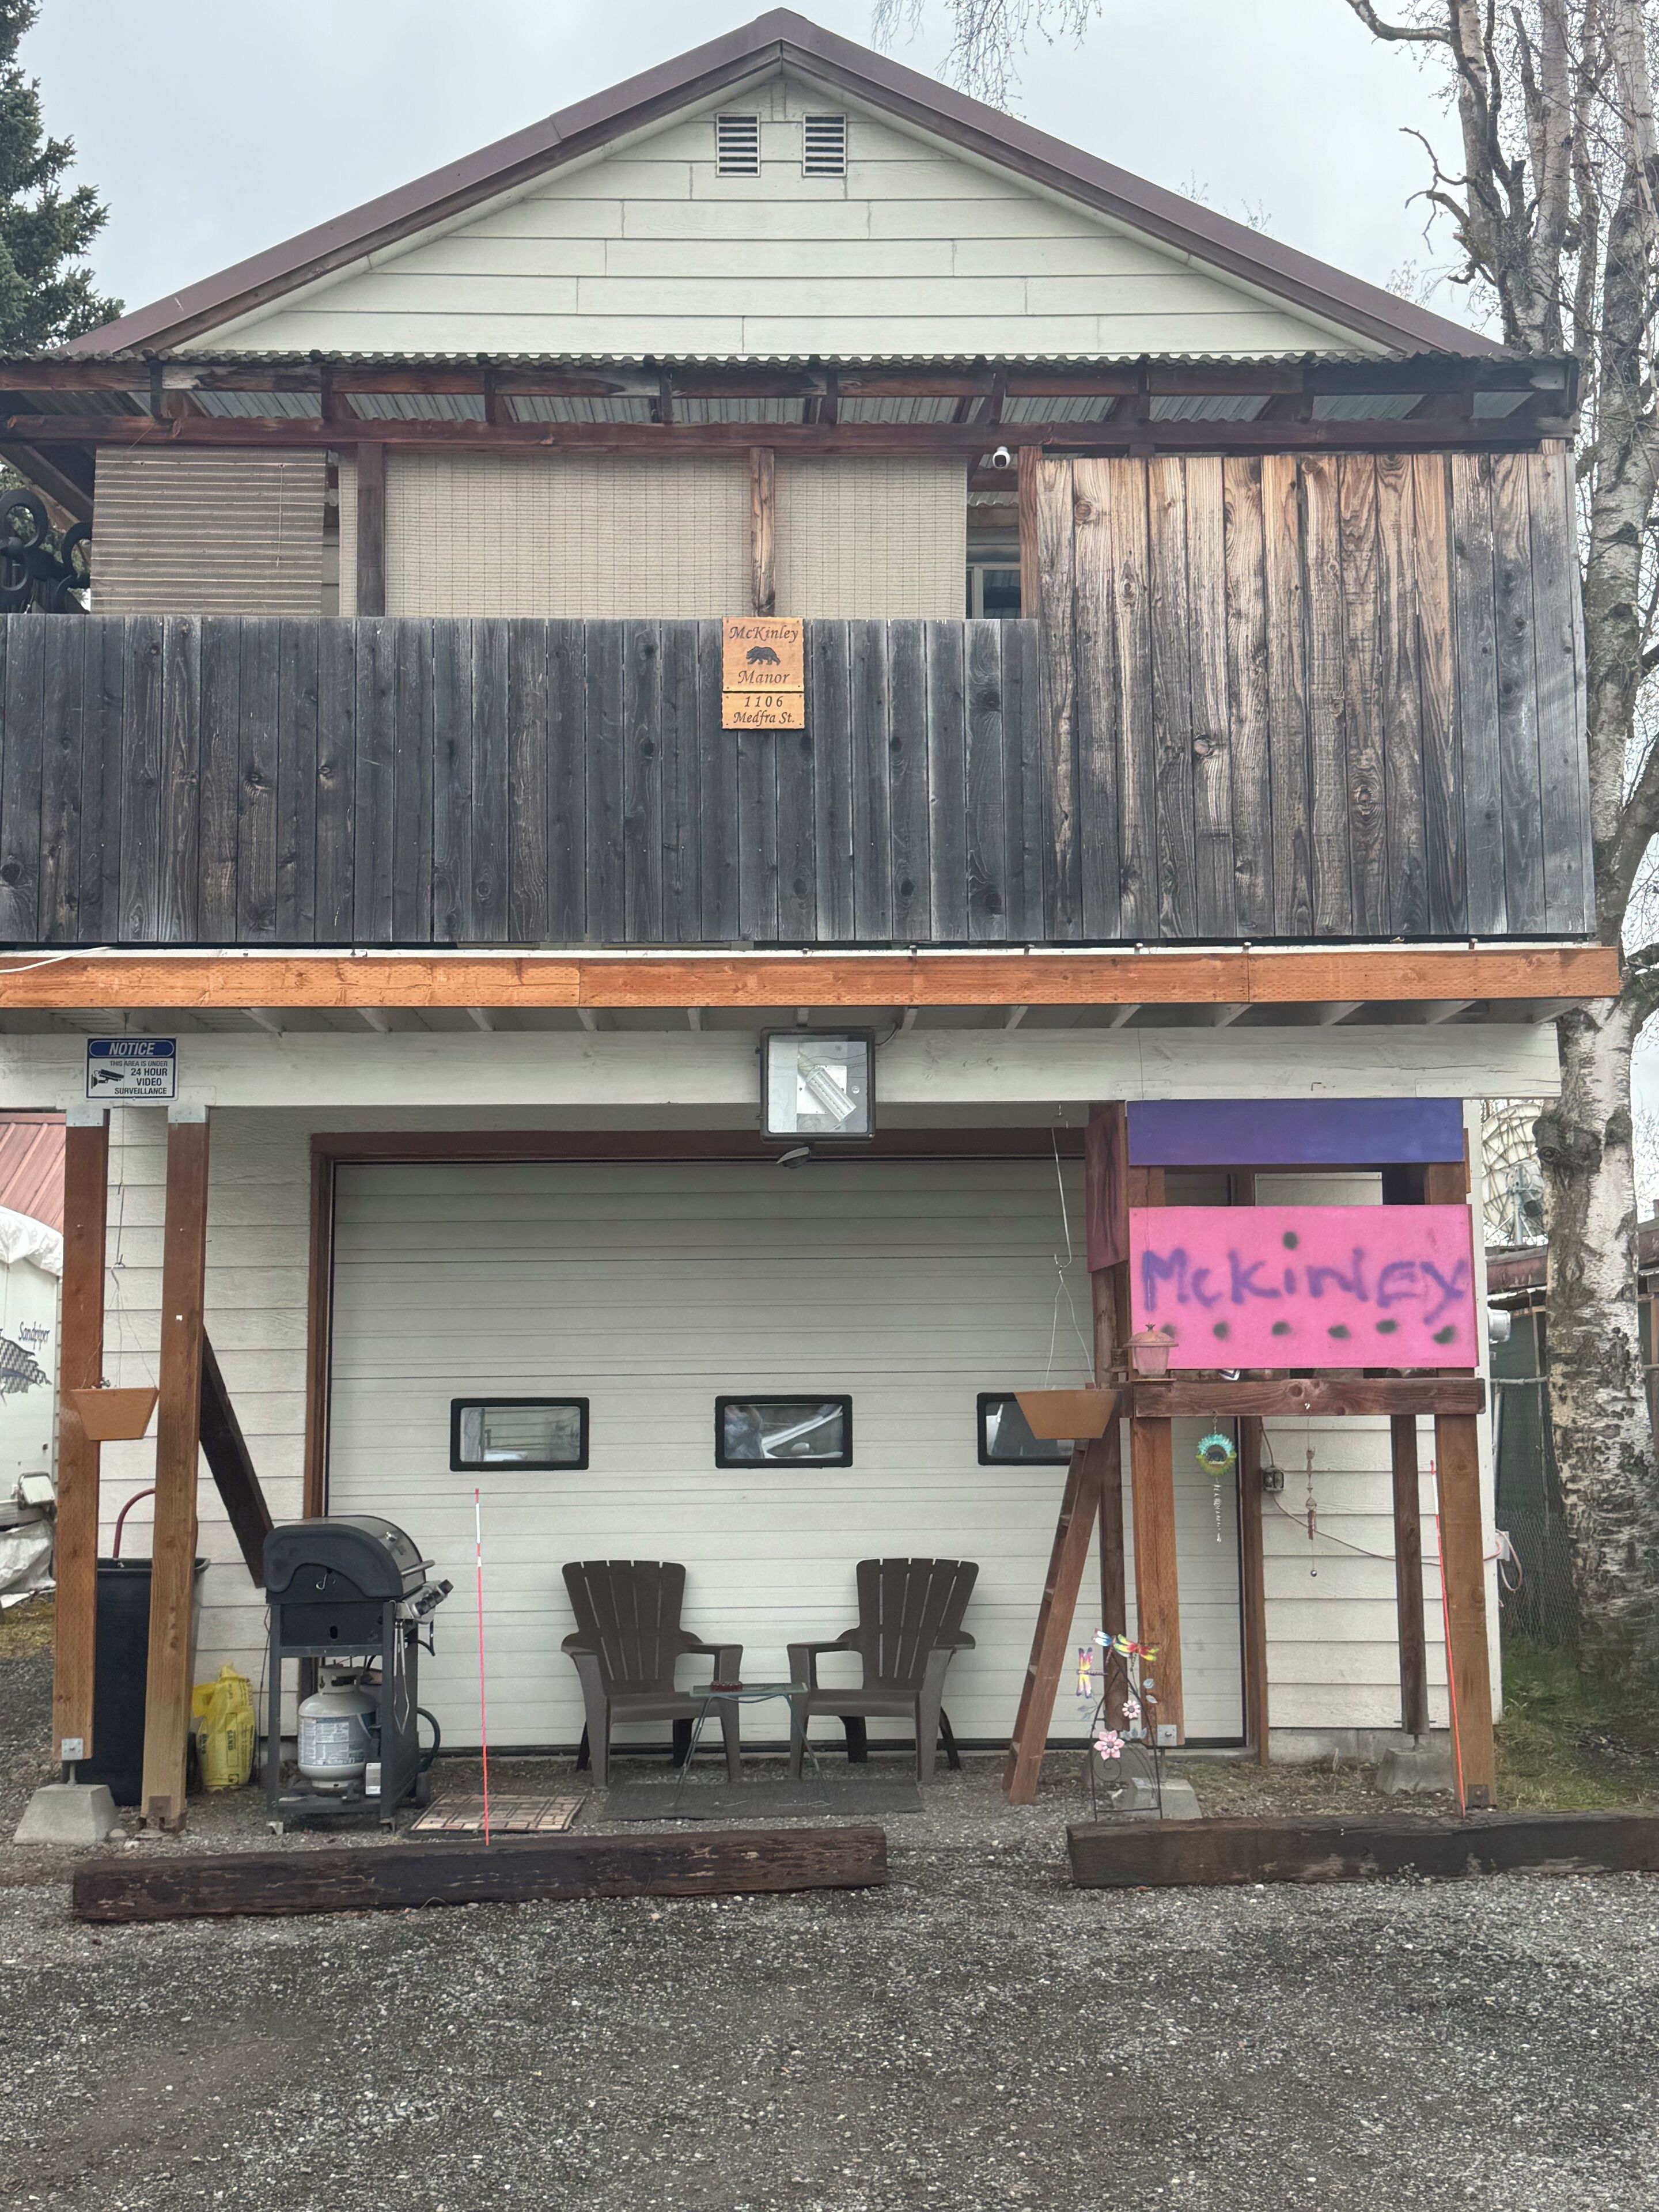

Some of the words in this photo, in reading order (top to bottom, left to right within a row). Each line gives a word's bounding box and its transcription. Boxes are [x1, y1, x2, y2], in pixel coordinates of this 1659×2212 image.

[729, 625, 798, 643] McKinley
[737, 670, 790, 684] Manor
[744, 696, 783, 707] 1106
[733, 710, 775, 726] Medfra
[779, 710, 795, 723] St.
[109, 1043, 156, 1055] NOTICE
[131, 1068, 141, 1076] 24
[144, 1068, 168, 1076] HOUR
[137, 1078, 162, 1086] VIDEO
